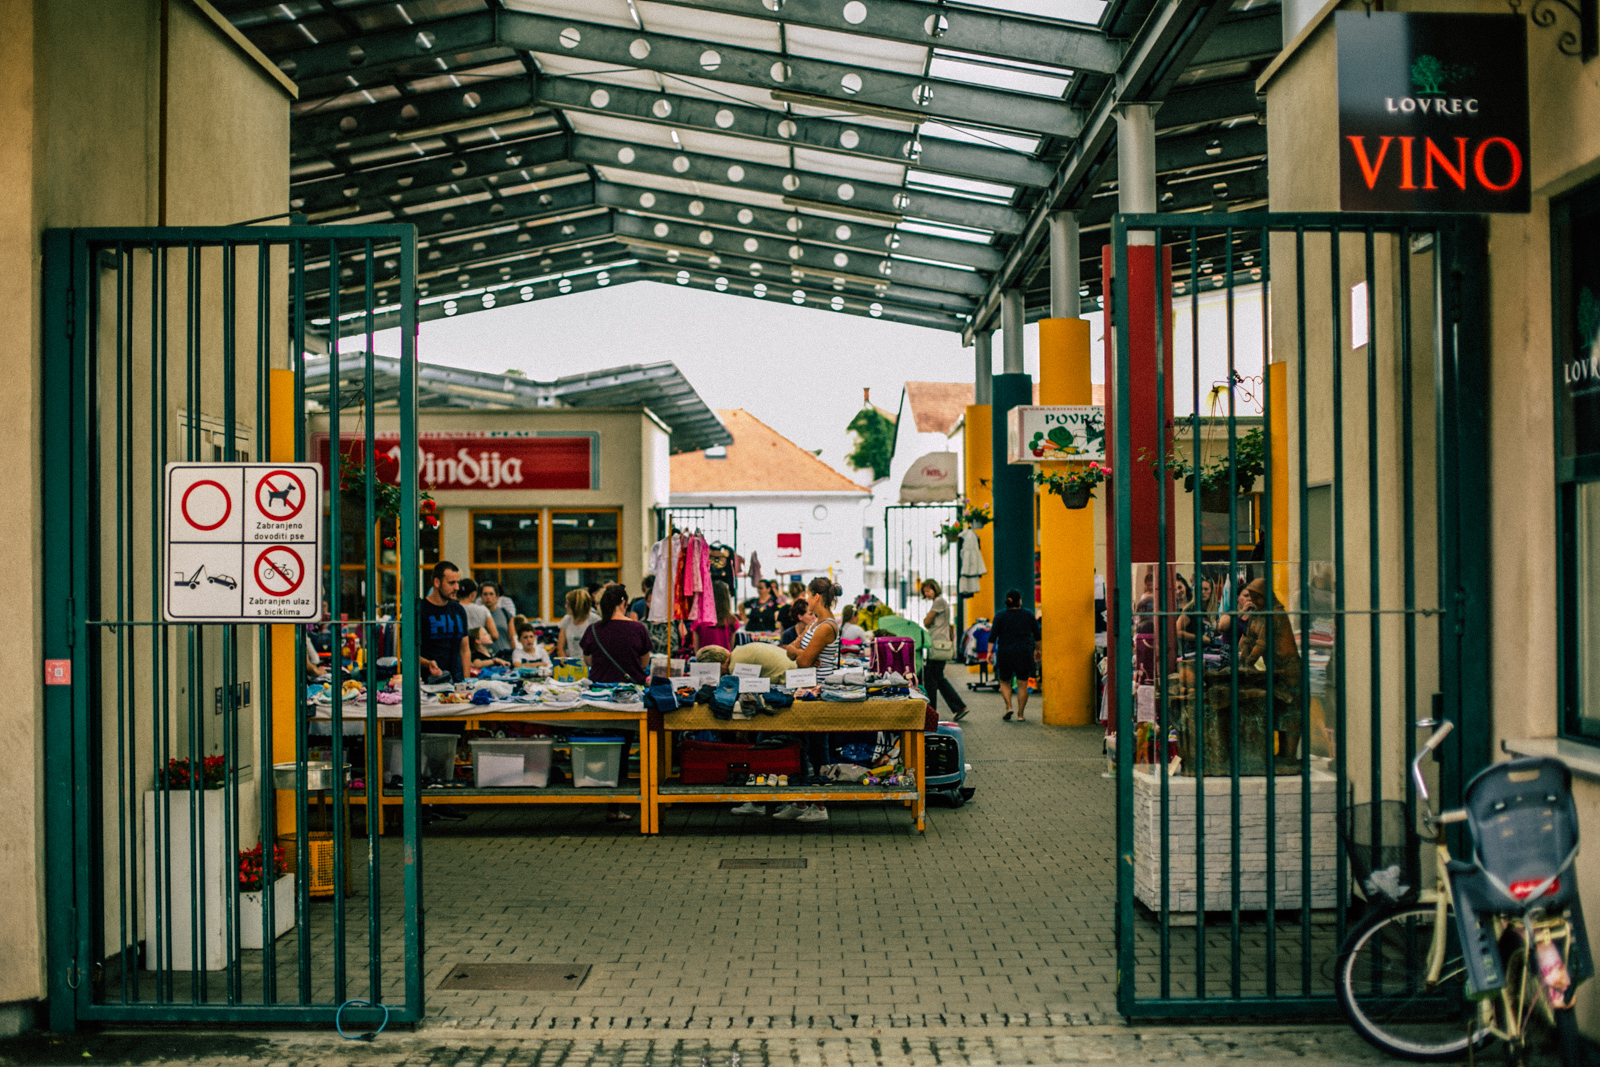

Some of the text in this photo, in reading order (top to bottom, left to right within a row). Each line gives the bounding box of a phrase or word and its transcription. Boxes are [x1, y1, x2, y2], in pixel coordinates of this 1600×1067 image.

[1385, 97, 1479, 114] LOVREC
[1346, 136, 1522, 191] VINO
[256, 522, 303, 531] Zabranjeno
[254, 532, 305, 541] dovoditi pse
[249, 597, 310, 606] Zabranjen ulaz
[265, 608, 301, 616] biciklima
